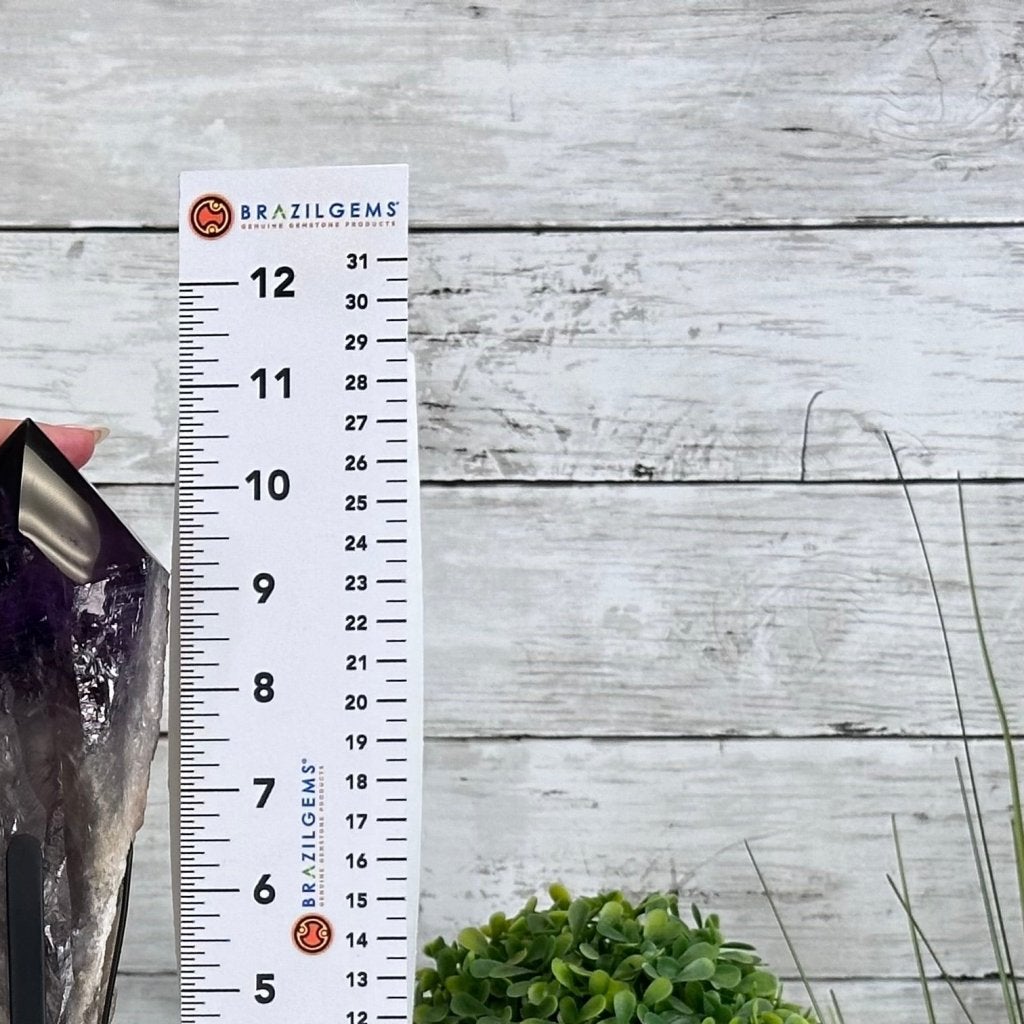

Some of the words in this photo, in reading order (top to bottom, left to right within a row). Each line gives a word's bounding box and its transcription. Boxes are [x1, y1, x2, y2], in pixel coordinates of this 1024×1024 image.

[240, 201, 397, 220] BRAZILGEMS
[346, 253, 368, 270] 31
[250, 265, 297, 299] 12
[345, 293, 369, 310] 30
[344, 333, 368, 351] 29
[250, 367, 291, 400] 11
[345, 374, 368, 391] 28
[344, 414, 368, 432] 27
[344, 454, 368, 471] 26
[245, 469, 291, 501] 10
[344, 494, 368, 511] 25
[344, 534, 368, 552] 24
[252, 572, 276, 604] 9
[344, 574, 368, 591] 23
[344, 614, 368, 631] 22
[345, 654, 367, 671] 21
[253, 671, 275, 704] 8
[344, 694, 368, 711] 20
[345, 734, 368, 751] 19
[345, 773, 368, 790] 18
[253, 777, 276, 809] 7
[345, 813, 368, 830] 17
[301, 764, 316, 908] BRAZILGEMS
[345, 852, 368, 869] 16
[253, 873, 276, 905] 6
[345, 892, 368, 909] 15
[345, 932, 368, 948] 14
[346, 971, 368, 988] 13
[254, 973, 276, 1005] 5
